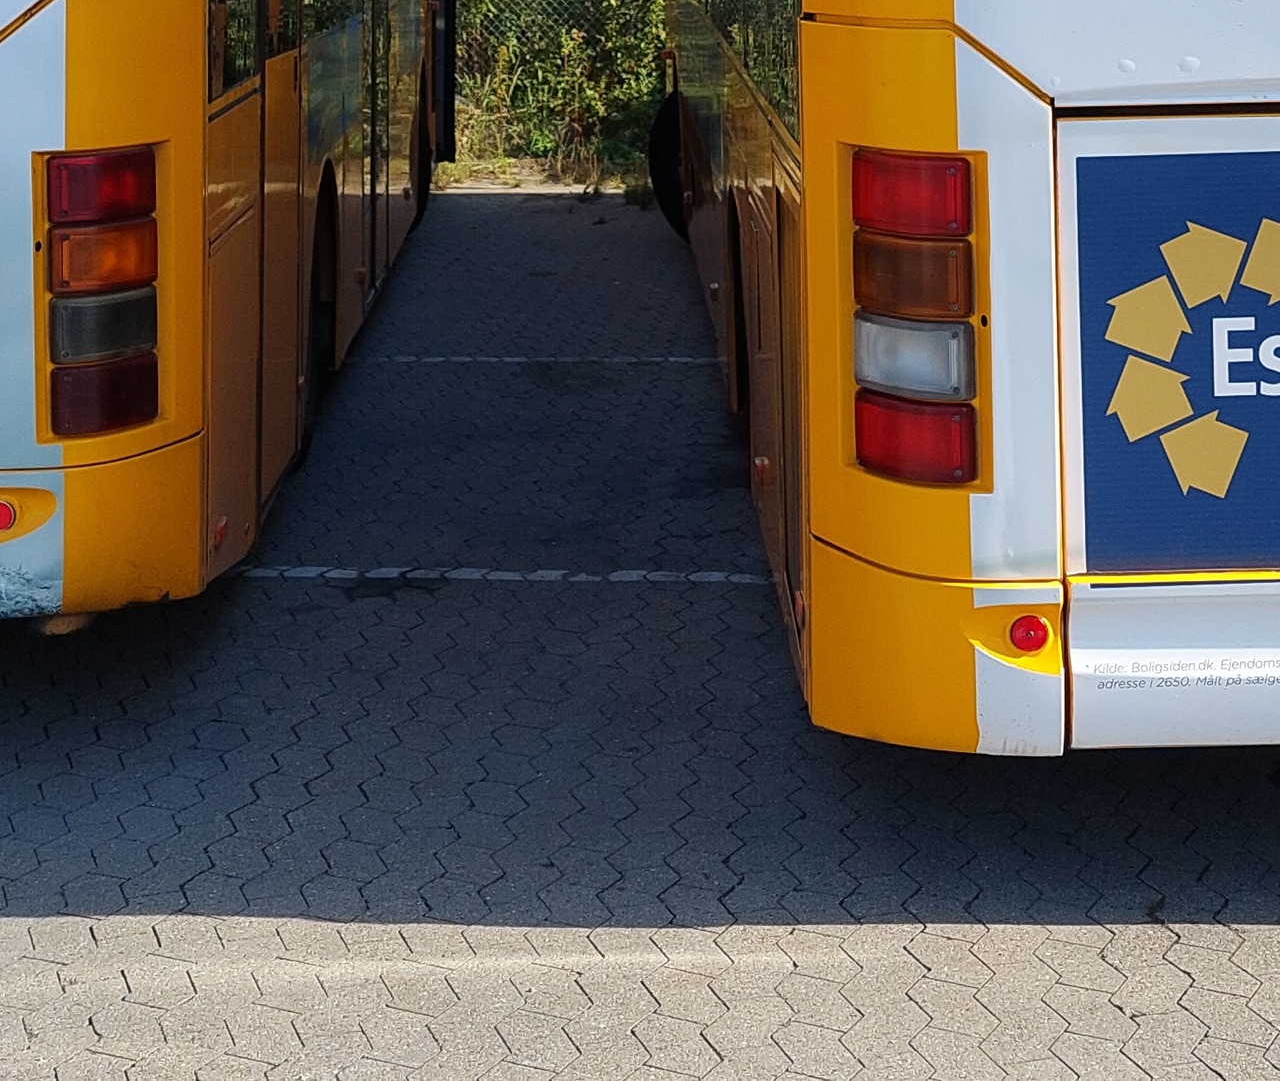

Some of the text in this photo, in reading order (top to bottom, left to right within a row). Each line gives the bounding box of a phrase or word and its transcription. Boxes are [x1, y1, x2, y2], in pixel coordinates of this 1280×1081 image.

[1094, 662, 1128, 675] Kilde:
[1097, 678, 1146, 690] adresse
[1149, 678, 1153, 689] i
[1156, 676, 1192, 688] 2650.
[1196, 674, 1222, 687] Målt
[1225, 674, 1242, 688] på
